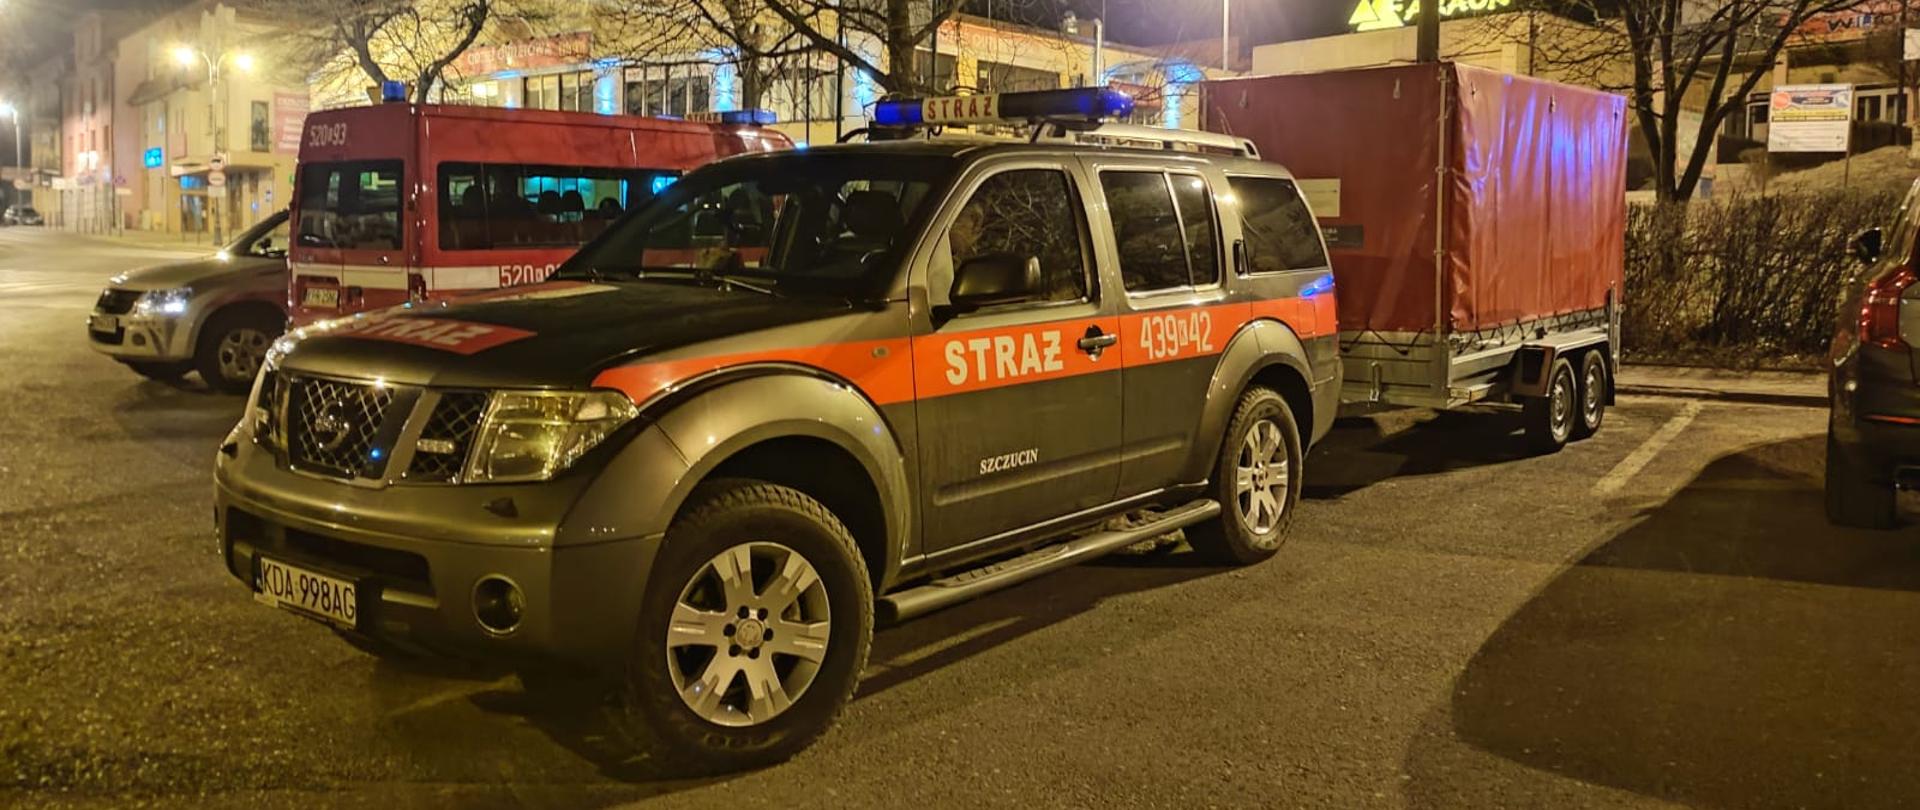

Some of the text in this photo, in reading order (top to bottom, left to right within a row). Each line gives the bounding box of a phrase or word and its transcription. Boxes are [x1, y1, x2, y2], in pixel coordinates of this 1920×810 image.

[945, 330, 1064, 386] STRAŻ
[980, 448, 1038, 475] SZCZUCIN
[262, 561, 355, 620] KDA 998AG
